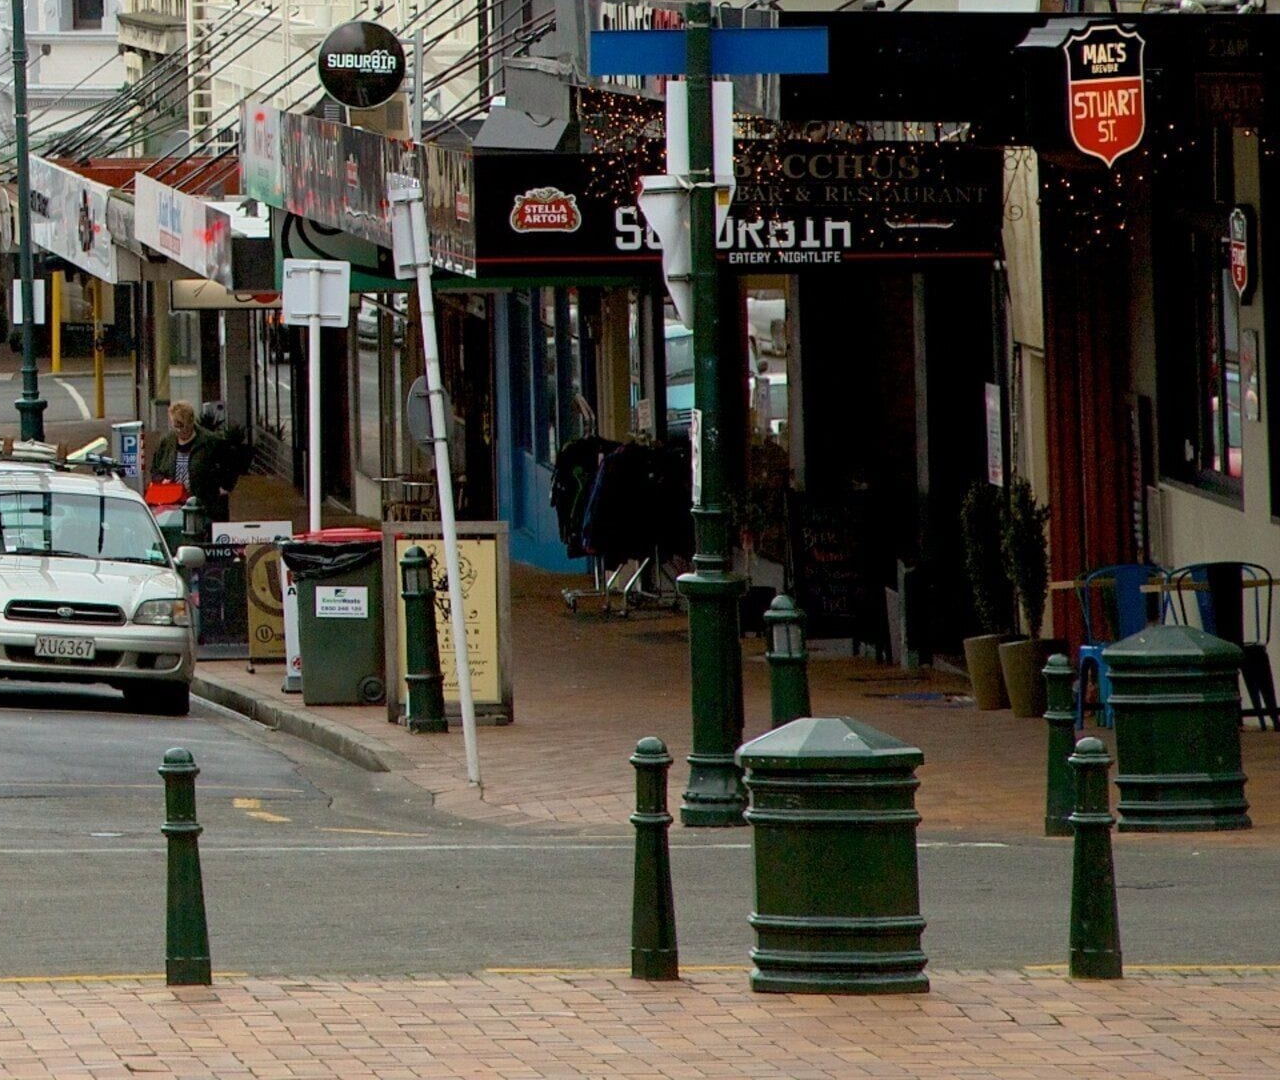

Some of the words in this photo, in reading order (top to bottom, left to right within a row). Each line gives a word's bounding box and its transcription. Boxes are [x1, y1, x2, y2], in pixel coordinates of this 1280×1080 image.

[327, 53, 396, 70] SUBURBIA
[1082, 42, 1127, 65] MAC'S
[1074, 88, 1139, 119] STUART
[1098, 119, 1118, 143] ST.
[733, 154, 921, 180] BACCHUS
[737, 186, 783, 202] BAR
[796, 187, 811, 202] &
[825, 186, 987, 203] RESTAURANT
[523, 204, 567, 214] STELLA
[523, 213, 568, 223] ARTOIS
[729, 252, 772, 265] EATERY
[780, 251, 841, 264] NIGHTLIFE
[124, 436, 137, 452] P
[204, 548, 232, 557] VING
[38, 637, 93, 656] XU6367
